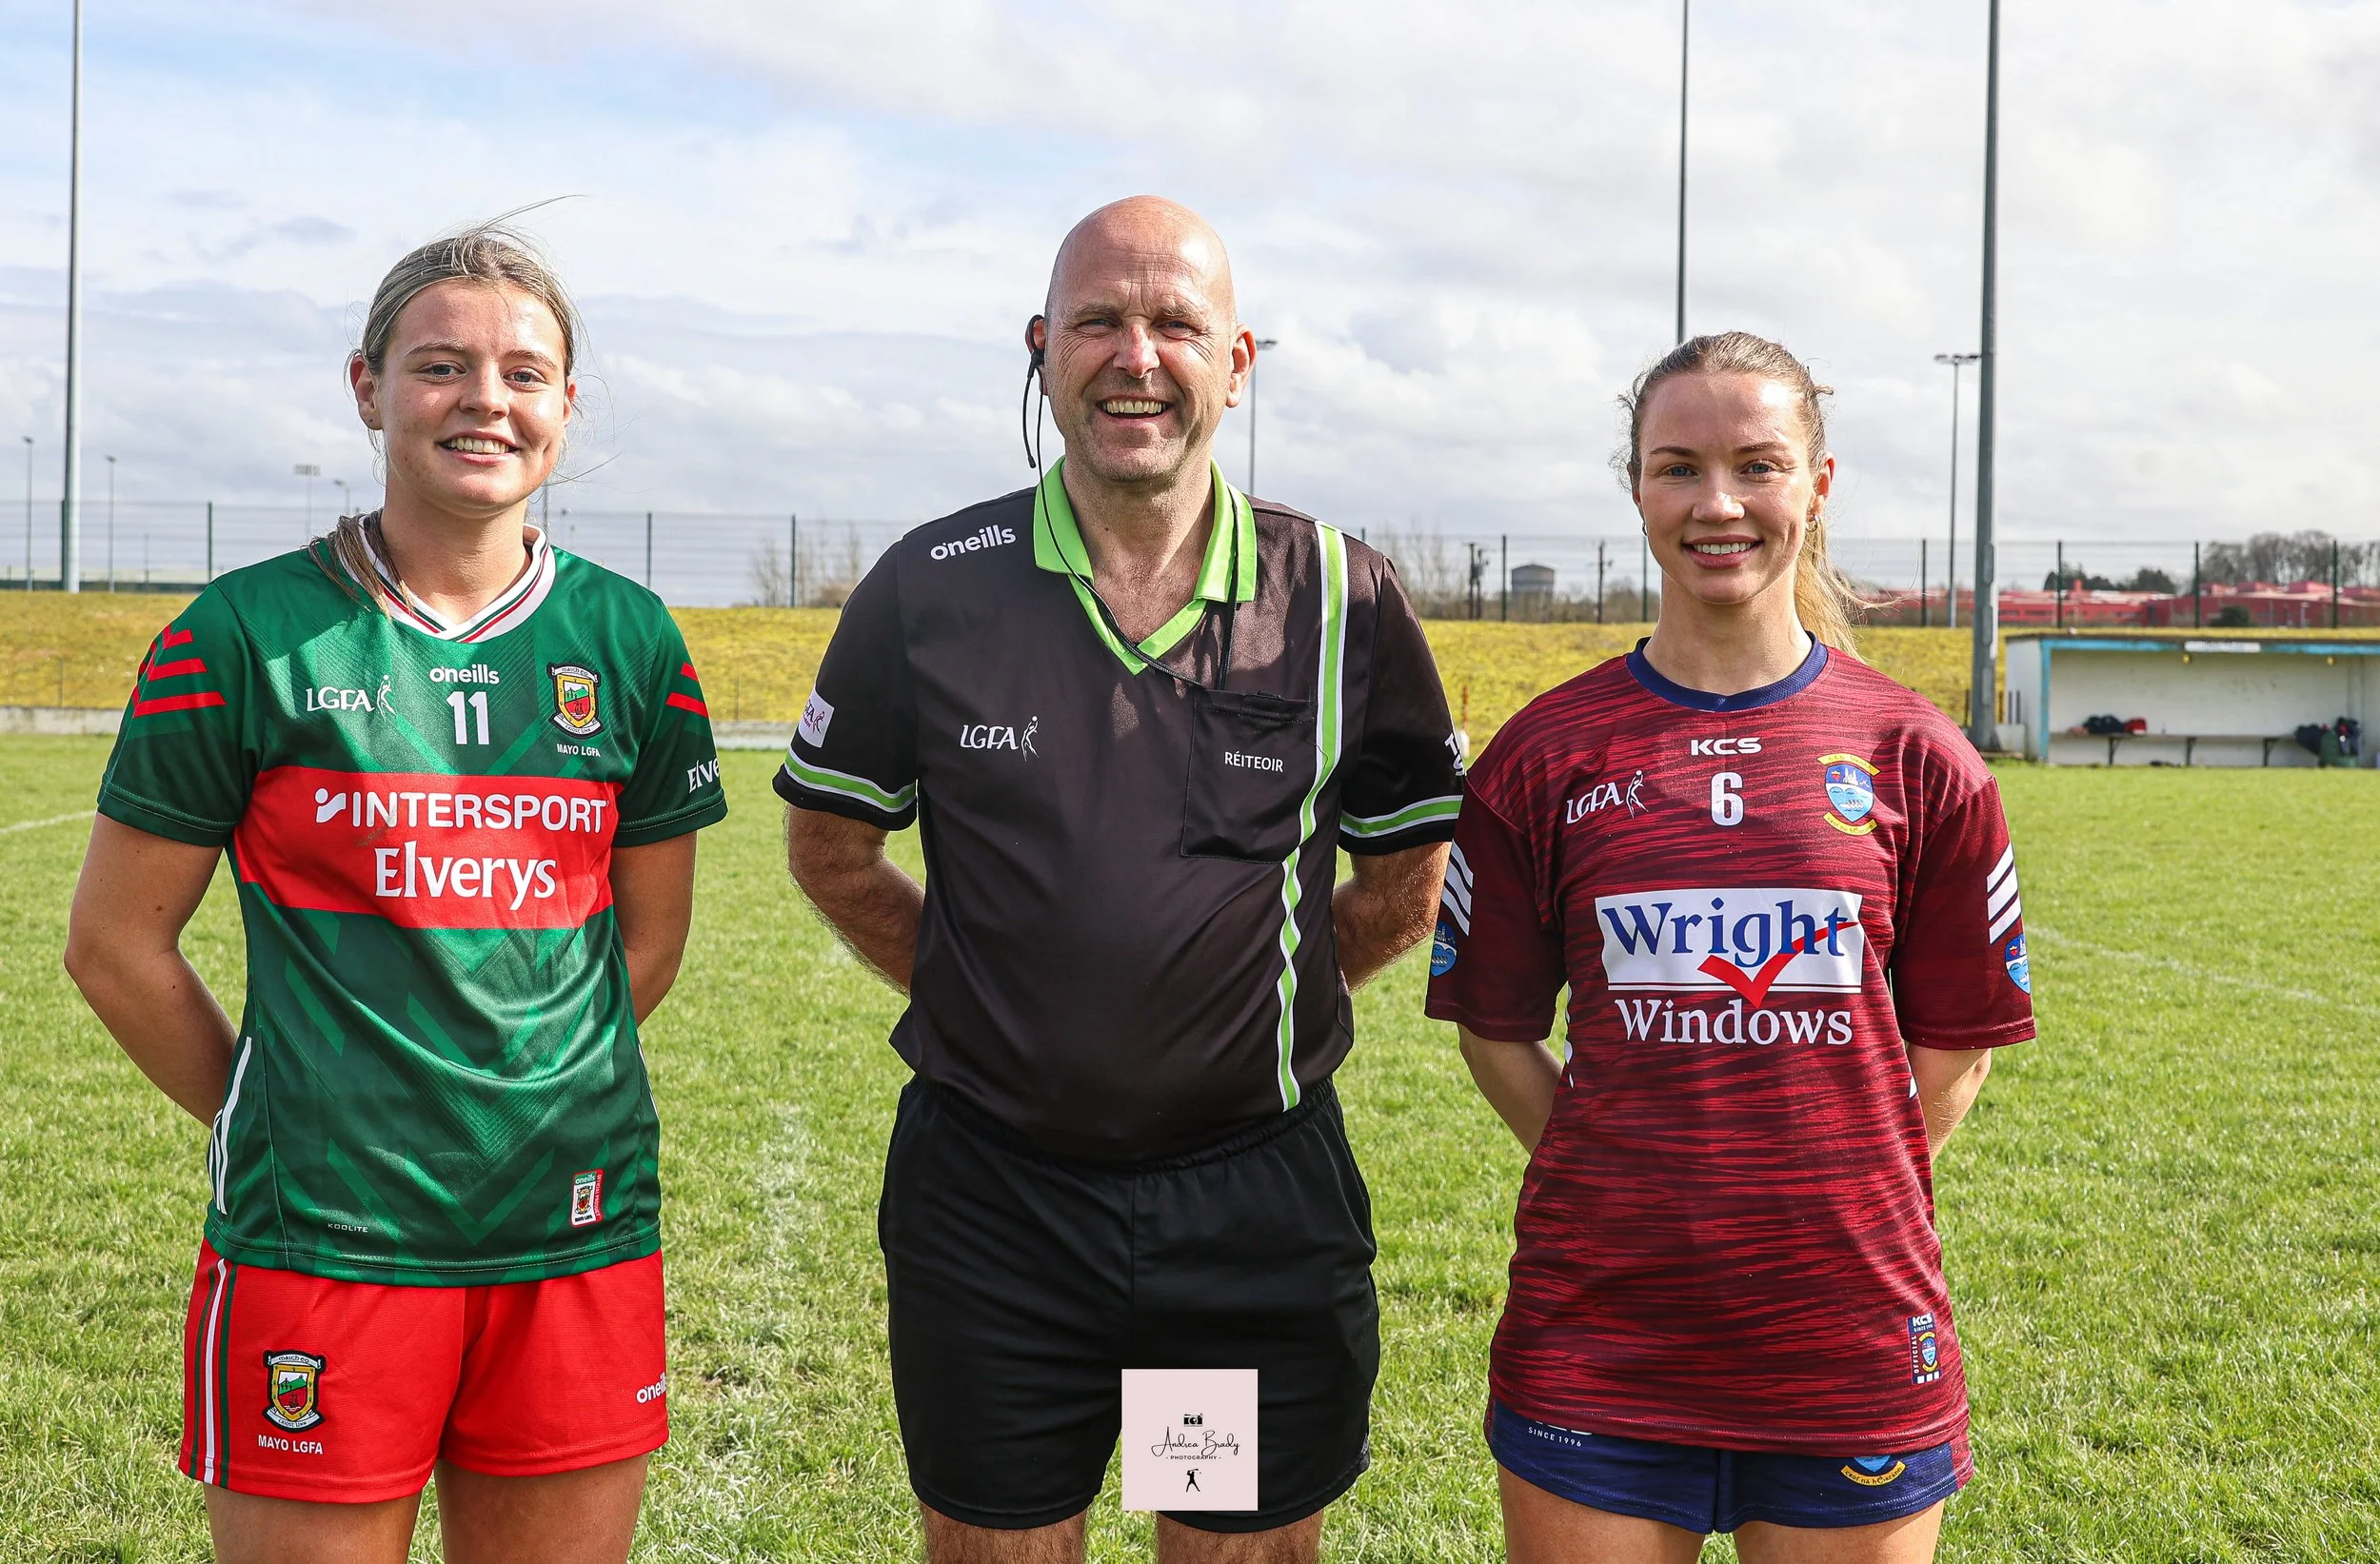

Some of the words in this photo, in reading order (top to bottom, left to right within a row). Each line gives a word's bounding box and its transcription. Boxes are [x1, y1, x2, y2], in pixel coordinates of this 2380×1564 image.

[305, 685, 376, 712] LGFA
[446, 690, 490, 745] 11
[556, 742, 579, 756] MAYO
[581, 745, 602, 758] LGFA
[960, 724, 1020, 750] LGFA
[1691, 737, 1762, 756] KCS
[1224, 750, 1283, 773] RÉITEOIR
[1566, 782, 1624, 824] LGFA
[1711, 771, 1744, 826] 6
[352, 791, 607, 834] INTERSPORT
[374, 840, 558, 911] Elverys
[1601, 897, 1848, 968] Wright
[1614, 998, 1853, 1045] Windows
[327, 1222, 368, 1233] KOOLITE
[1912, 1313, 1933, 1327] KCS
[1911, 1335, 1920, 1374] OFFICIAL
[258, 1434, 289, 1451] MAYO
[292, 1439, 324, 1455] LGFA
[1528, 1426, 1556, 1441] SINCE
[1558, 1435, 1581, 1448] 1996
